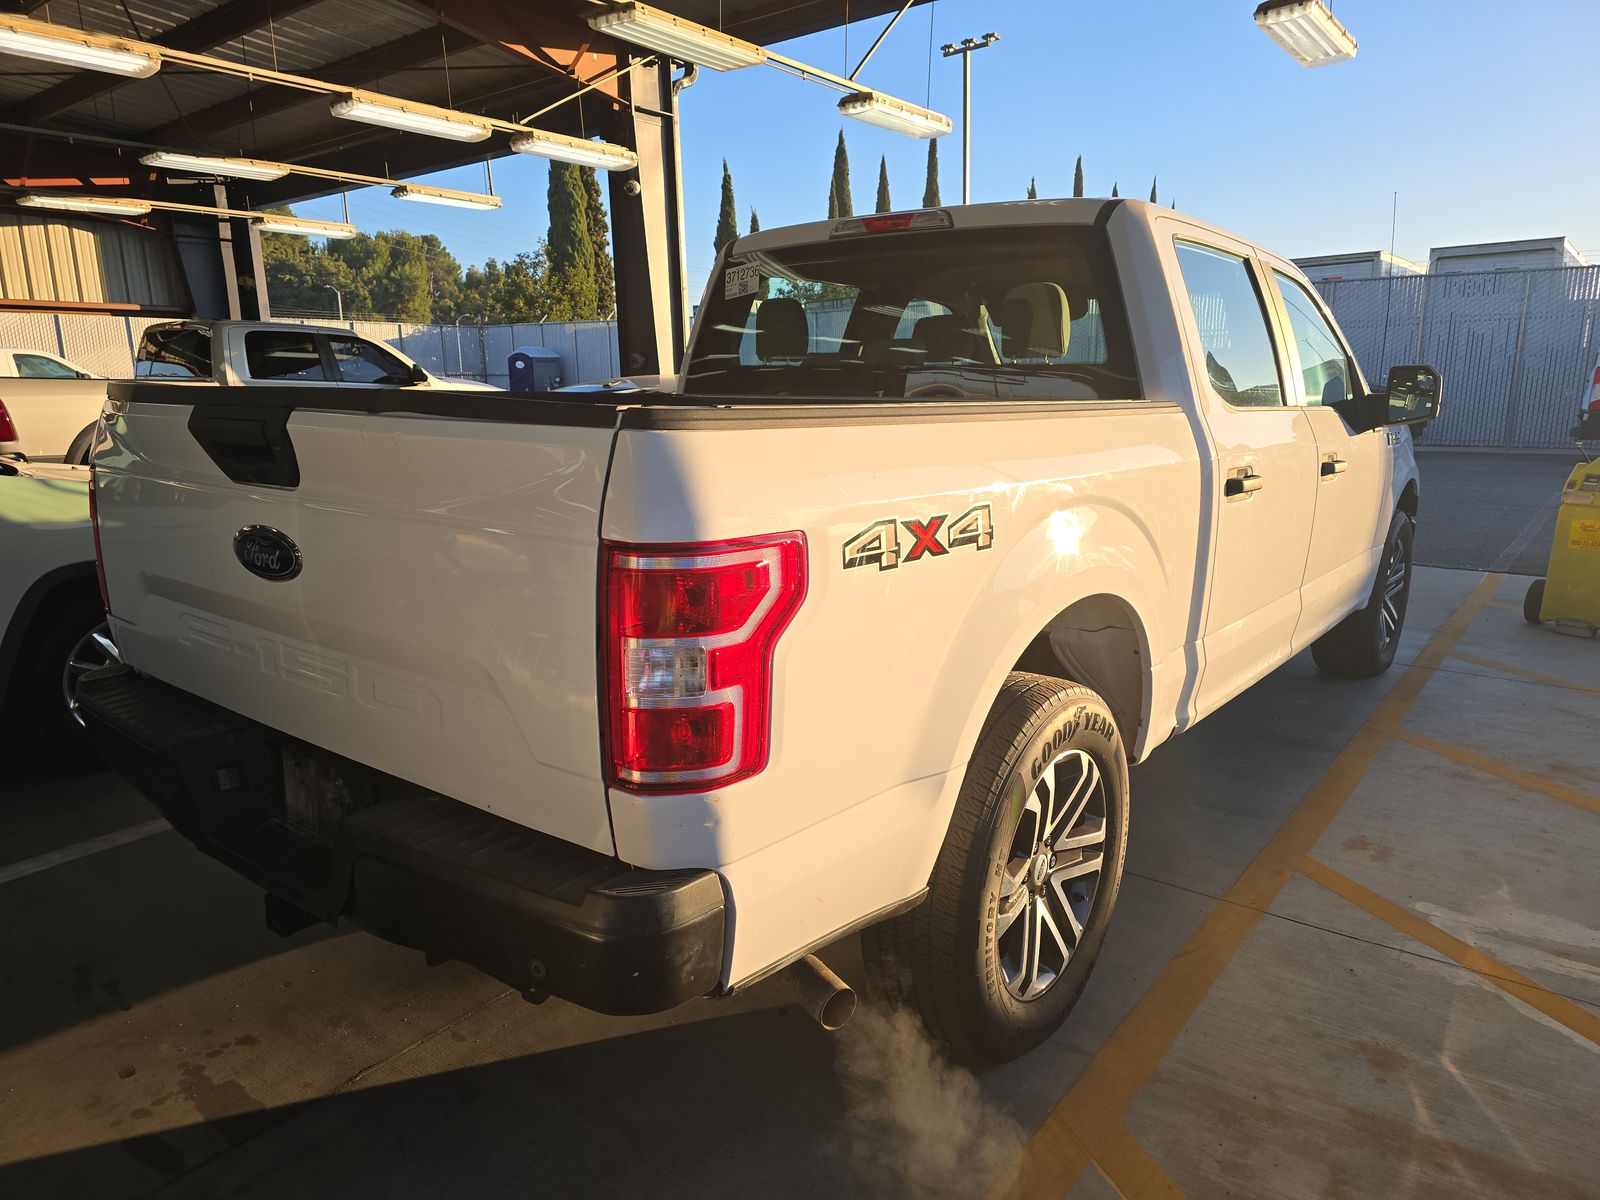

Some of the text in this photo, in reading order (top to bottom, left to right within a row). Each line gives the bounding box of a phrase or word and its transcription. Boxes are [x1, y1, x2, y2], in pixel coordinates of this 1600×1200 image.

[726, 264, 760, 284] 3712736
[244, 538, 281, 570] Ford
[177, 611, 444, 729] F-150
[985, 891, 997, 1001] TERRITORY
